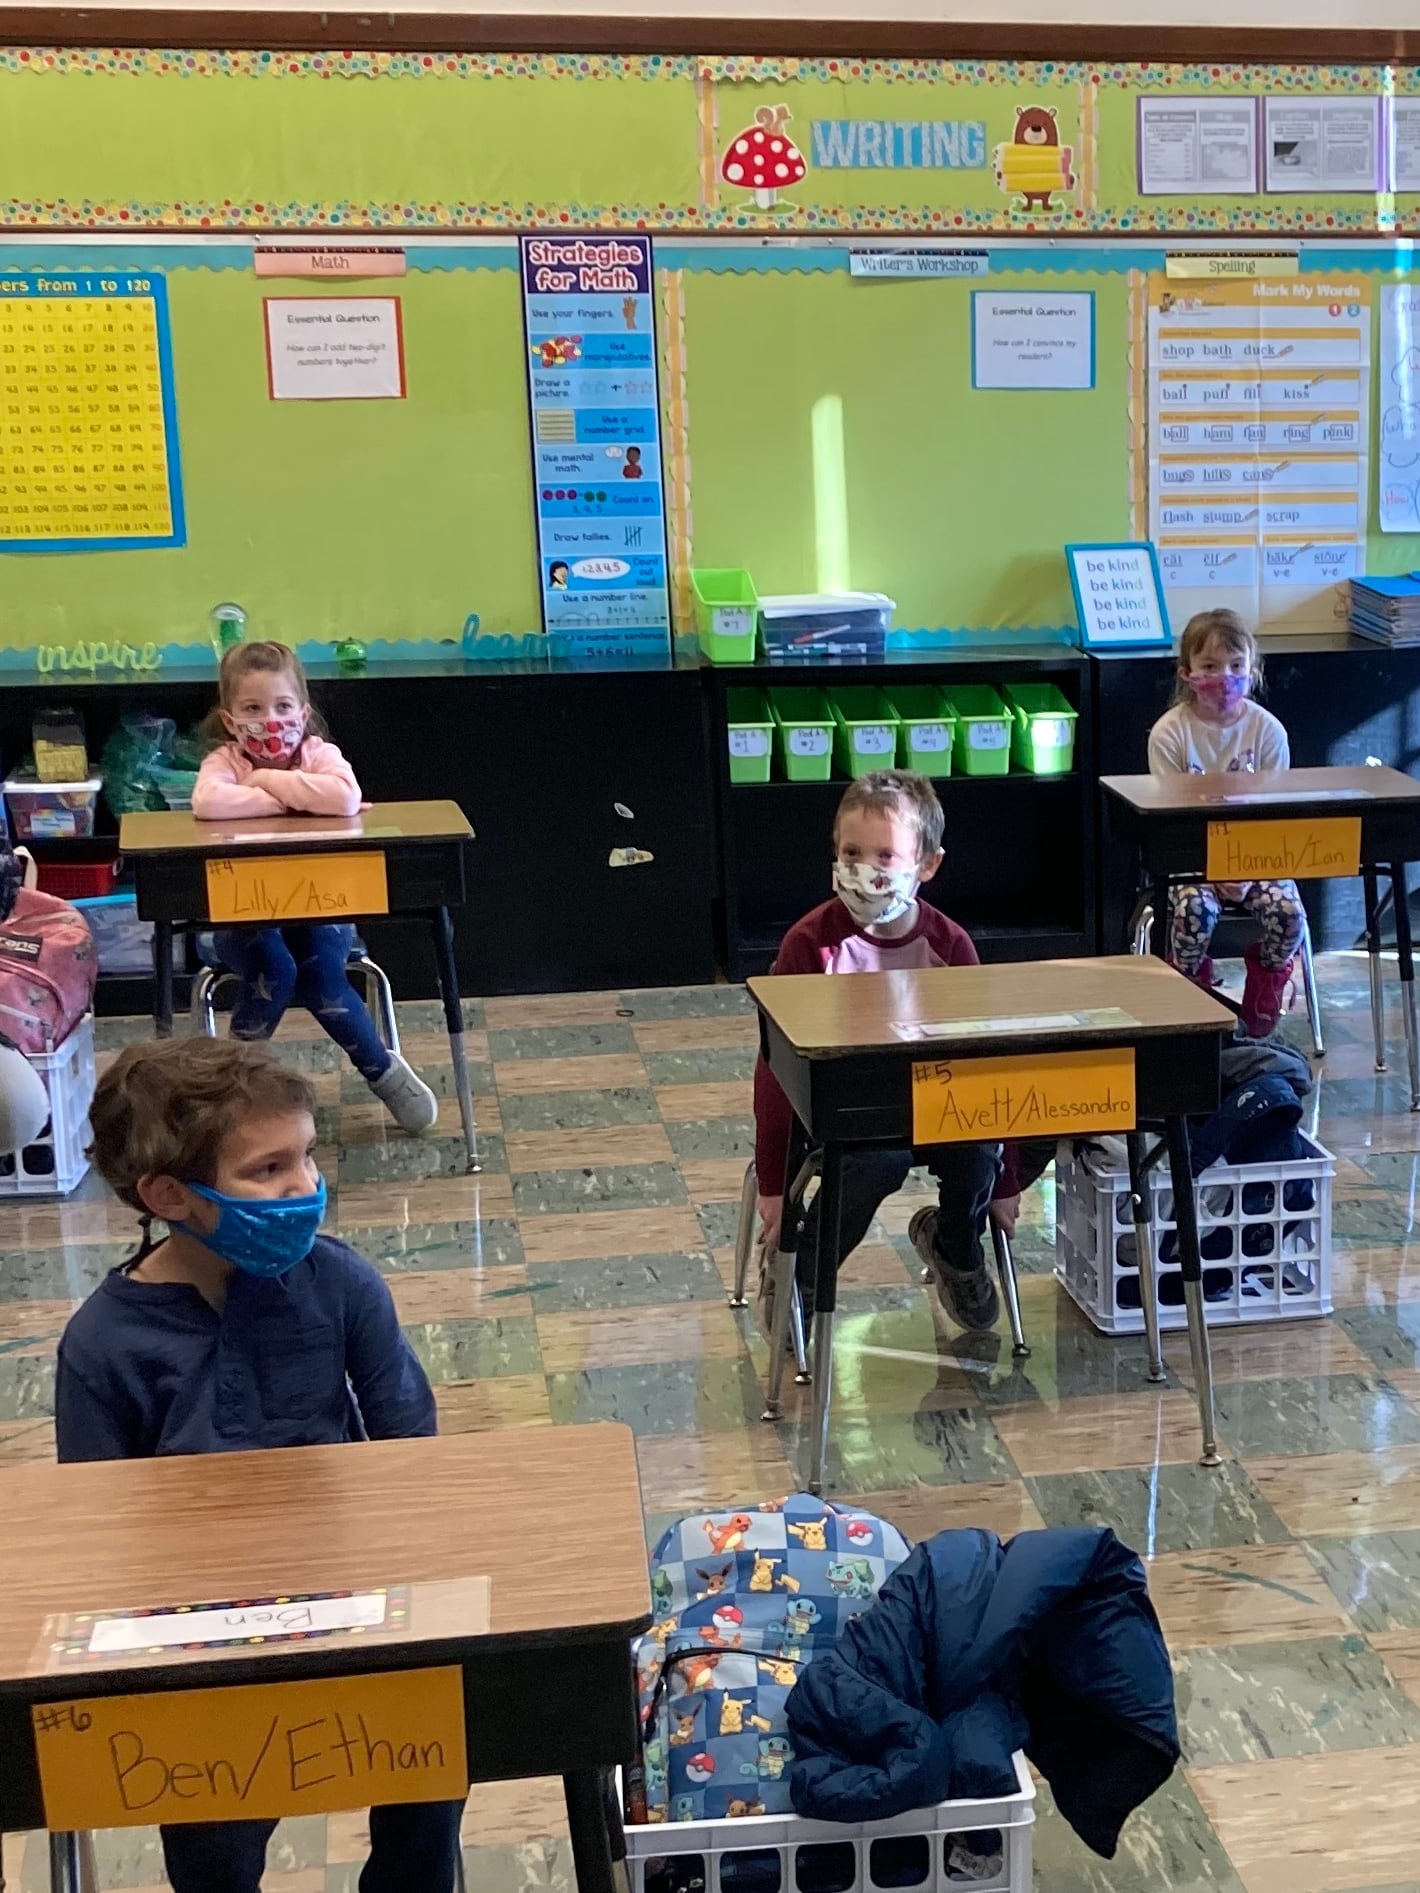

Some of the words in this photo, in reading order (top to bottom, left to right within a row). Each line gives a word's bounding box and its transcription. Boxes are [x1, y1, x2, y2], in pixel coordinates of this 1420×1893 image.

[811, 120, 986, 168] WRITING
[311, 255, 350, 269] Math
[529, 242, 642, 267] Strategies
[861, 256, 913, 271] Writer's
[918, 257, 979, 273] Workshop
[1208, 259, 1256, 274] Spelling
[0, 279, 29, 291] ers
[37, 278, 77, 292] from
[86, 280, 92, 291] 1
[100, 279, 118, 291] to
[127, 279, 151, 291] 120
[536, 269, 576, 290] for
[581, 269, 638, 291] Math
[1253, 283, 1289, 297] Mark
[1293, 283, 1313, 299] My
[1316, 283, 1361, 297] Words
[287, 314, 332, 324] Essential
[336, 313, 381, 324] Question
[1162, 344, 1195, 358] shop
[1203, 343, 1232, 357] bath
[1243, 343, 1276, 357] duck
[1283, 388, 1311, 400] kiss
[1266, 511, 1300, 523] scrap
[1087, 560, 1105, 573] be
[1108, 559, 1139, 571] kind
[1090, 579, 1108, 592] be
[1112, 578, 1143, 591] kind
[1094, 599, 1112, 611] be
[1115, 598, 1147, 610] kind
[1097, 618, 1116, 630] be
[1119, 617, 1151, 630] kind
[37, 640, 164, 672] inspire
[1226, 833, 1345, 874] Hannah/Ian
[207, 859, 235, 875] #4
[232, 877, 348, 918] Lilly/Asa
[913, 1061, 953, 1085] #5
[937, 1085, 1131, 1134] Avett/Alessandro
[223, 1606, 313, 1630] Ben
[36, 1708, 93, 1734] #6
[109, 1713, 445, 1811] Ben/Ethan
